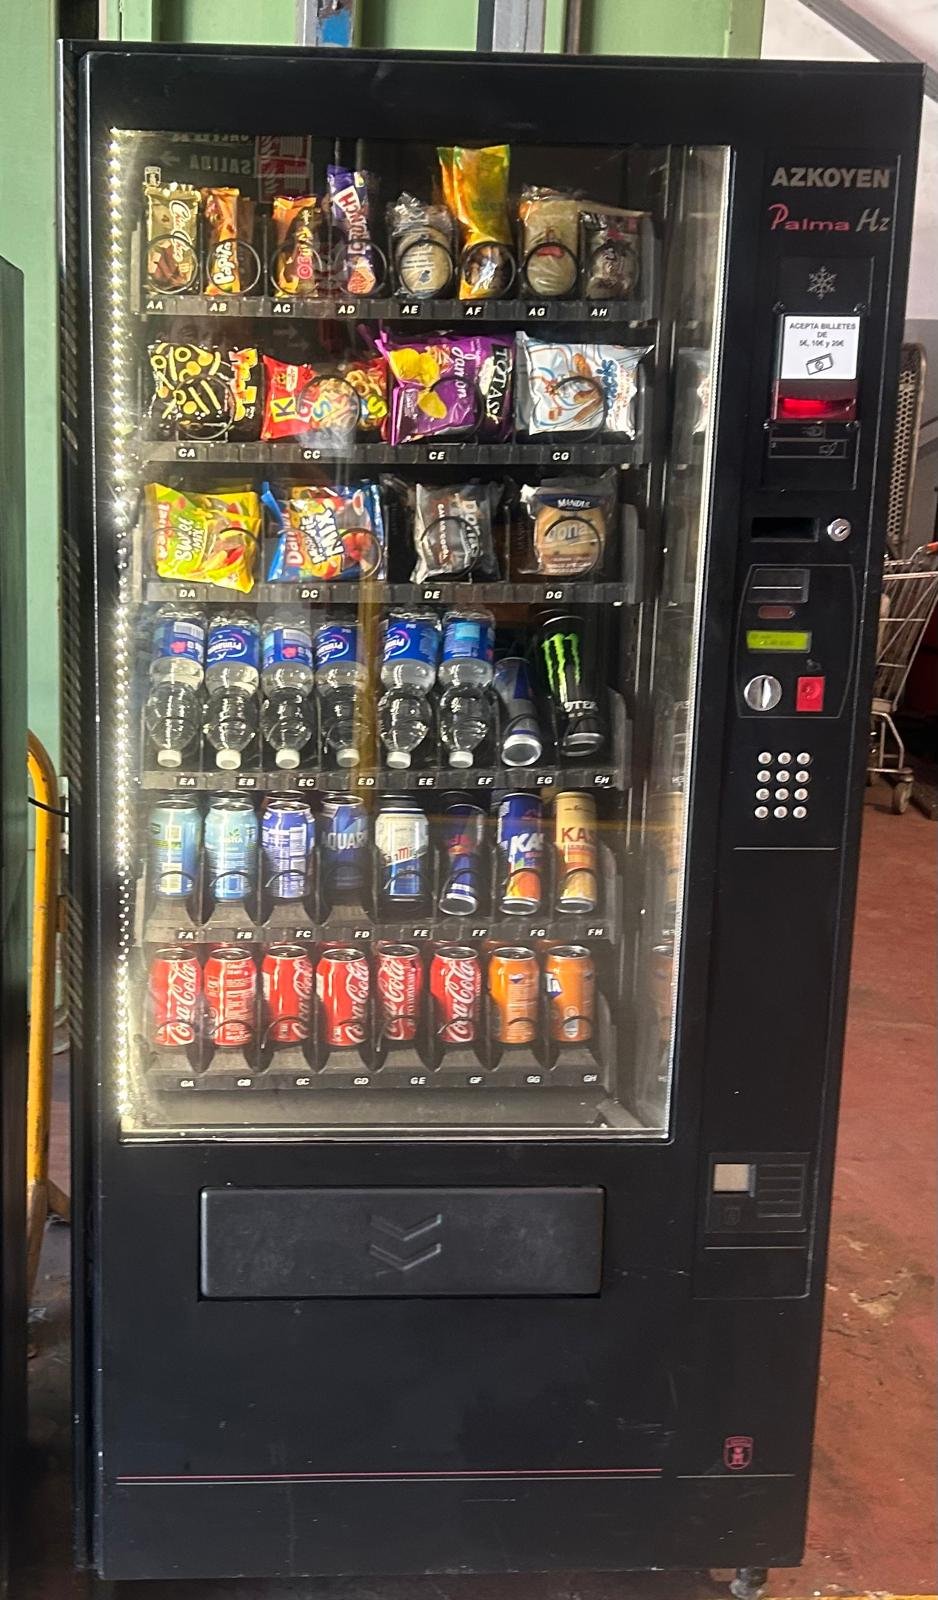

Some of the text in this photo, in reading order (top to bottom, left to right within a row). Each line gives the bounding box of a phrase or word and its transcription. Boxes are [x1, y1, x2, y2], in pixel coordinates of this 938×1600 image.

[770, 166, 891, 188] AZKOYEN
[768, 203, 891, 232] Palma Hz
[147, 300, 163, 310] AA
[210, 303, 227, 312] AB
[273, 304, 291, 313] AC
[338, 305, 356, 314] AD
[402, 305, 419, 314] AE
[466, 306, 482, 316] AF
[789, 322, 856, 330] ACEPTA BILLETES
[178, 448, 196, 458] CA
[303, 450, 321, 459] CC
[428, 451, 445, 460] CE
[179, 589, 196, 598] DA
[301, 589, 318, 598] DC
[424, 590, 441, 599] DE
[179, 777, 195, 786] EA
[238, 777, 255, 786] EB
[298, 778, 315, 787] EC
[358, 777, 375, 786] ED
[418, 777, 434, 786] EE
[477, 777, 493, 785] EF
[178, 931, 194, 940] FA
[236, 931, 253, 940] FB
[295, 930, 312, 939] FC
[354, 930, 370, 939] FD
[413, 929, 429, 937] FE
[472, 929, 487, 937] FF
[180, 1079, 195, 1088] GA
[237, 1078, 252, 1087] GB
[296, 1077, 310, 1086] GC
[353, 1077, 369, 1085] GD
[410, 1076, 426, 1085] GE
[469, 1075, 483, 1084] GF
